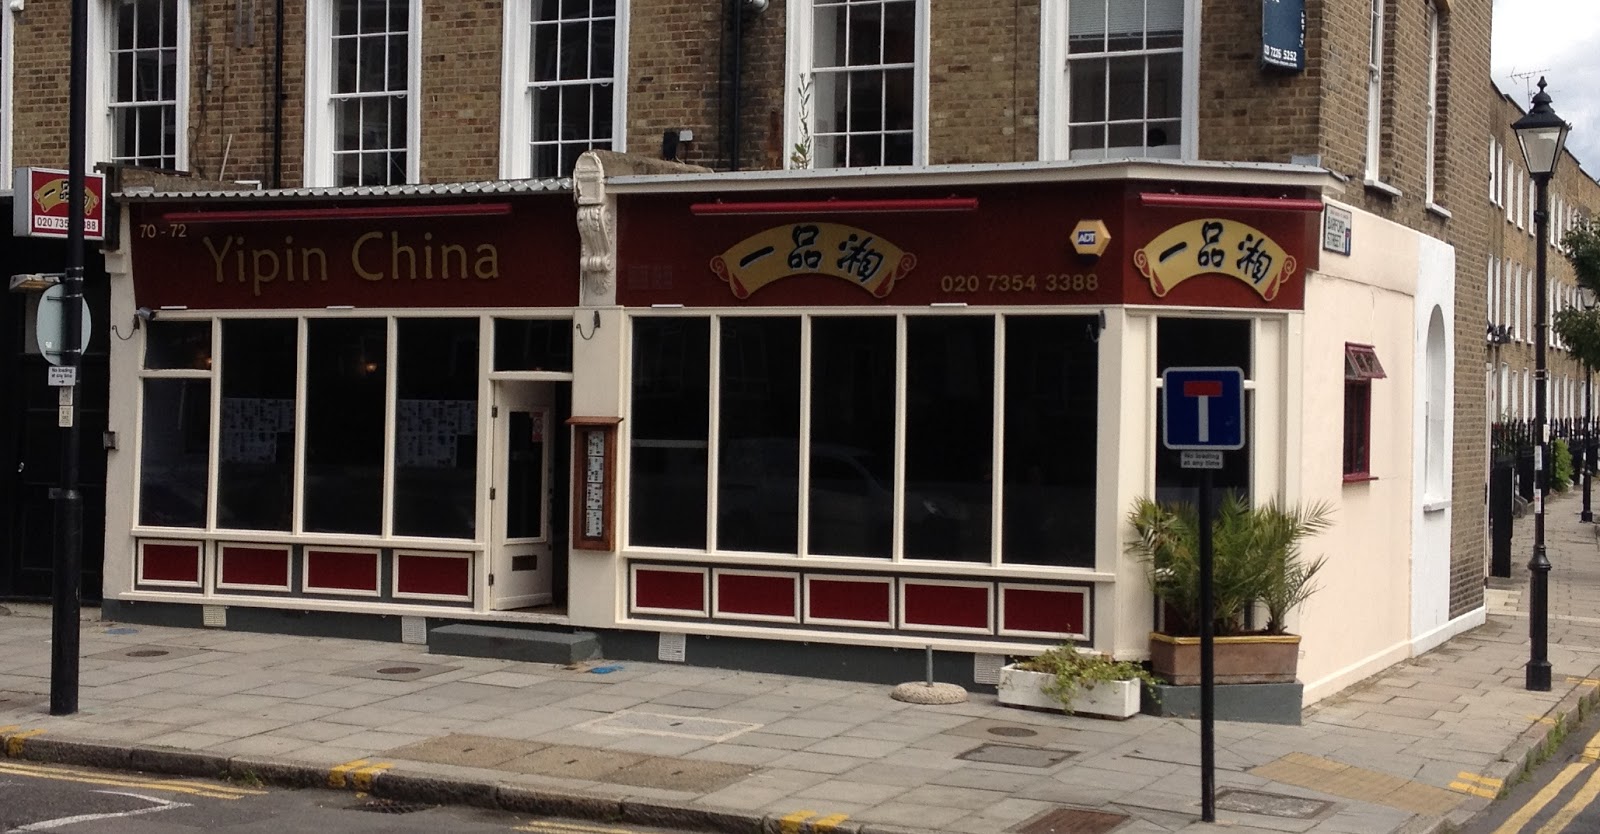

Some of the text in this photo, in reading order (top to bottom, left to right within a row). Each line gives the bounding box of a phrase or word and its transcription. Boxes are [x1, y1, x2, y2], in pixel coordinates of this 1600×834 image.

[1283, 49, 1297, 61] 5252
[37, 216, 52, 228] 020
[139, 224, 156, 238] 70
[170, 224, 187, 238] 72
[1077, 232, 1097, 245] ADT
[203, 231, 500, 297] Yipin China
[941, 273, 1099, 292] 020 7354 3388
[1195, 452, 1220, 460] loading
